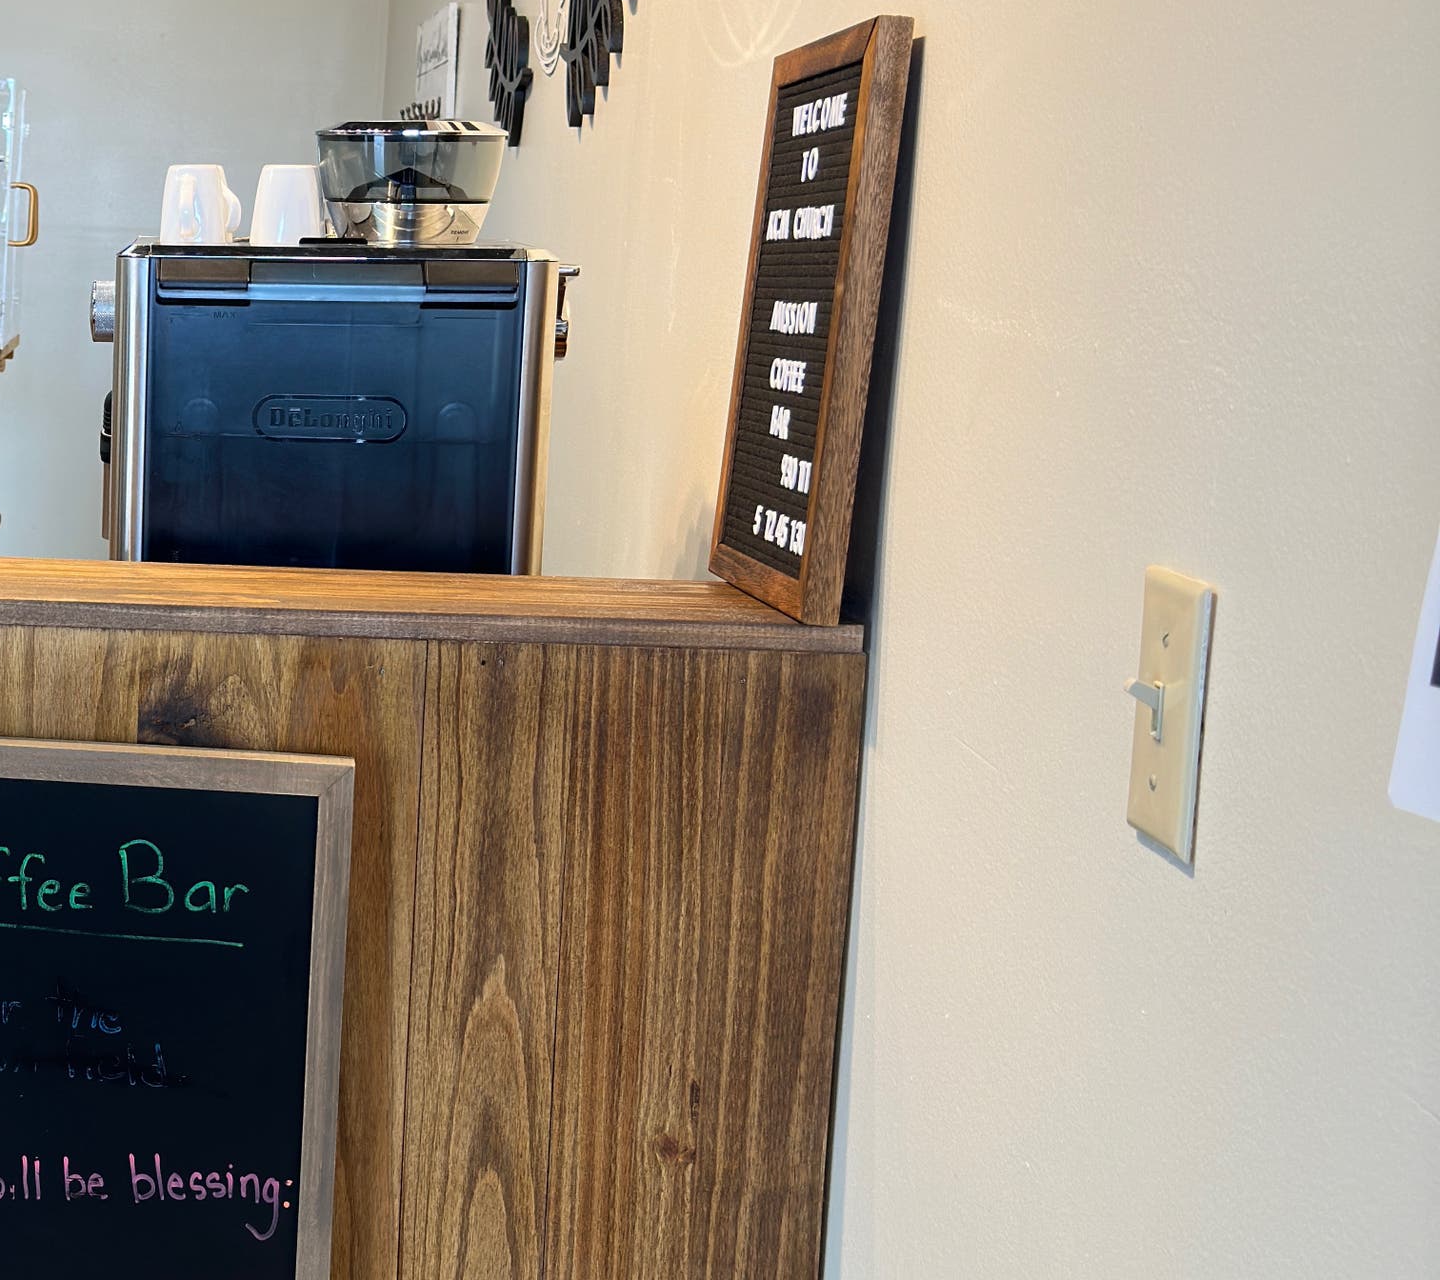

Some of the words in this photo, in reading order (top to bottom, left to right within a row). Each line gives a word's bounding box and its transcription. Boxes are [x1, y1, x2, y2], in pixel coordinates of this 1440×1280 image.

[792, 92, 849, 137] WELCOME
[800, 147, 819, 183] TO
[766, 209, 791, 241] KCM
[793, 204, 835, 240] CHURCH
[213, 311, 237, 320] MAX
[769, 300, 818, 335] MISSION
[769, 357, 807, 394] COFFEE
[769, 405, 791, 440] BAR
[119, 838, 250, 915] Bar
[65, 1156, 108, 1202] be
[128, 1153, 295, 1240] blessing:
